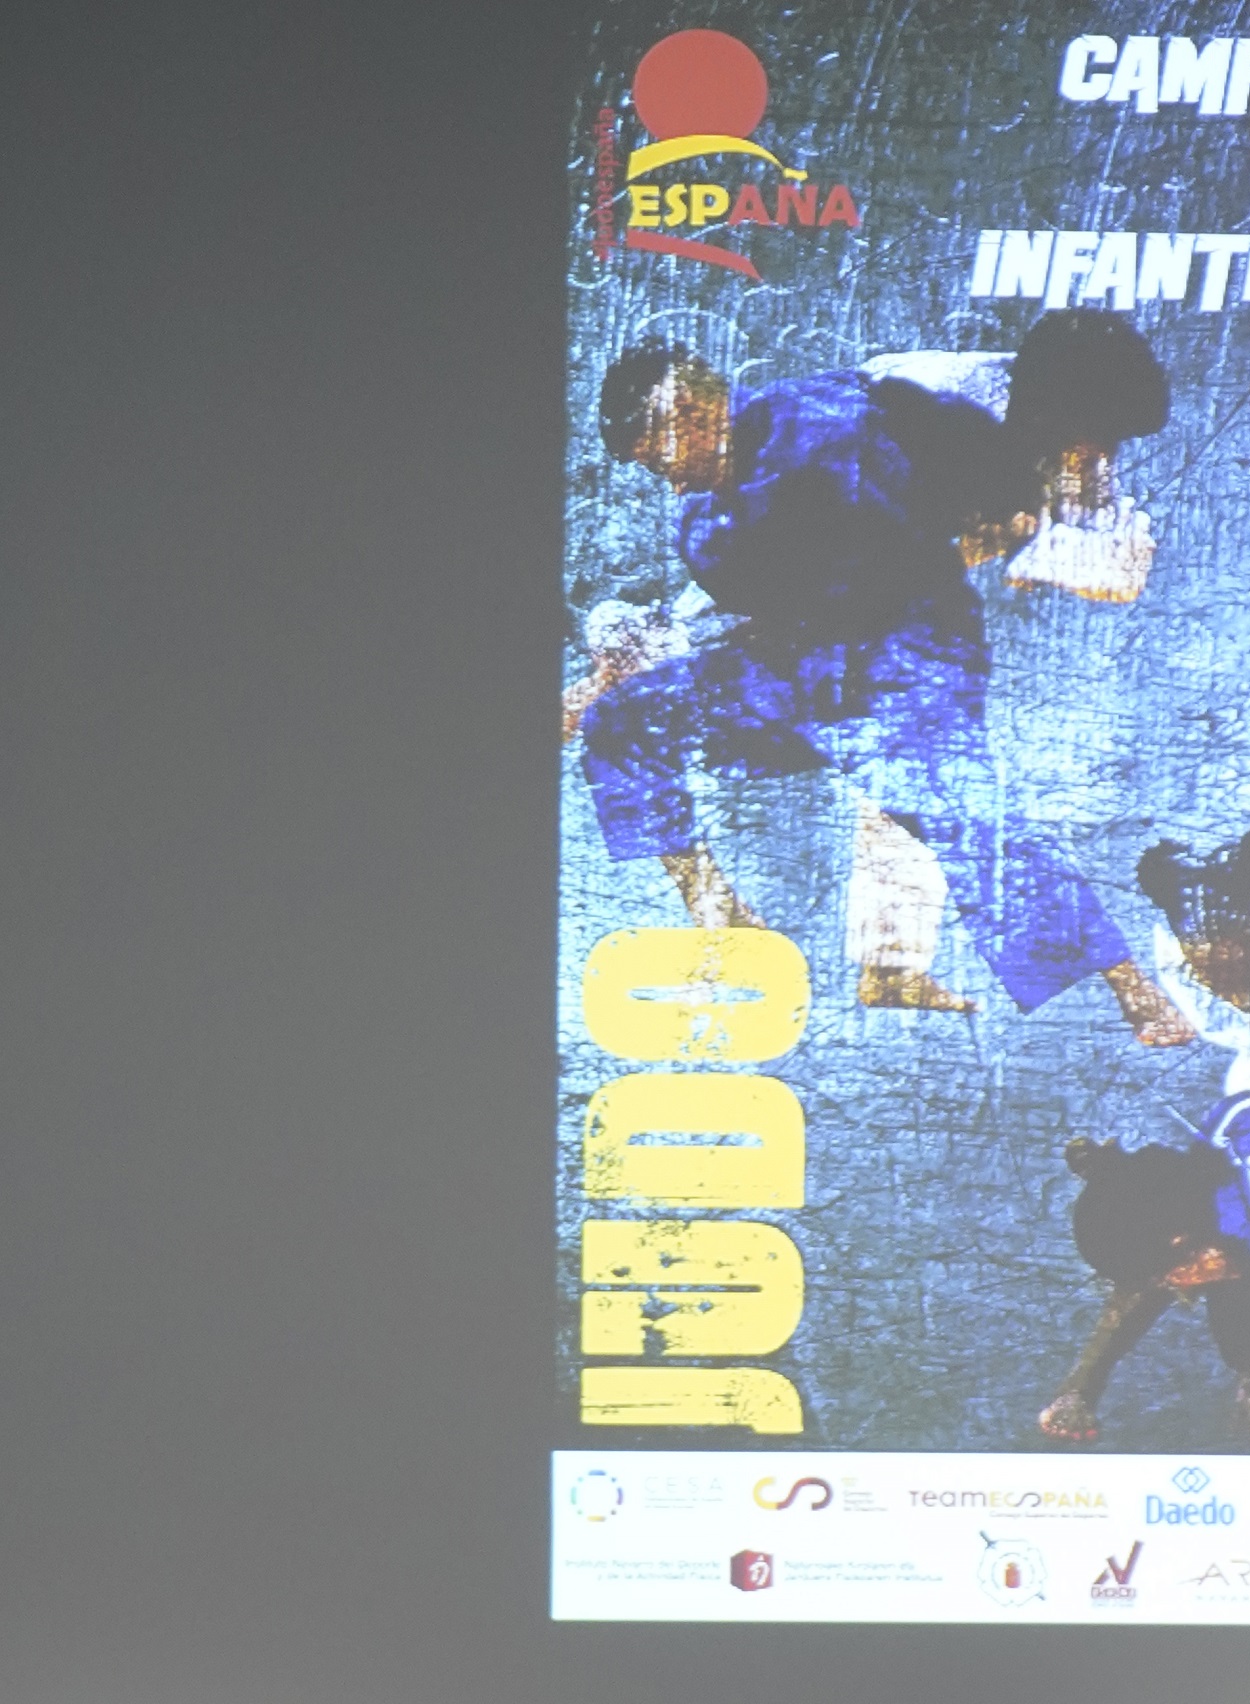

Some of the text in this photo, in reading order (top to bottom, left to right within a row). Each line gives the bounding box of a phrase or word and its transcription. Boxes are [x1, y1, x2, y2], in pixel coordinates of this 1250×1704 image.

[627, 169, 860, 228] ESPAÑA
[581, 927, 811, 1434] JUDO
[1146, 1495, 1236, 1526] Daedo
